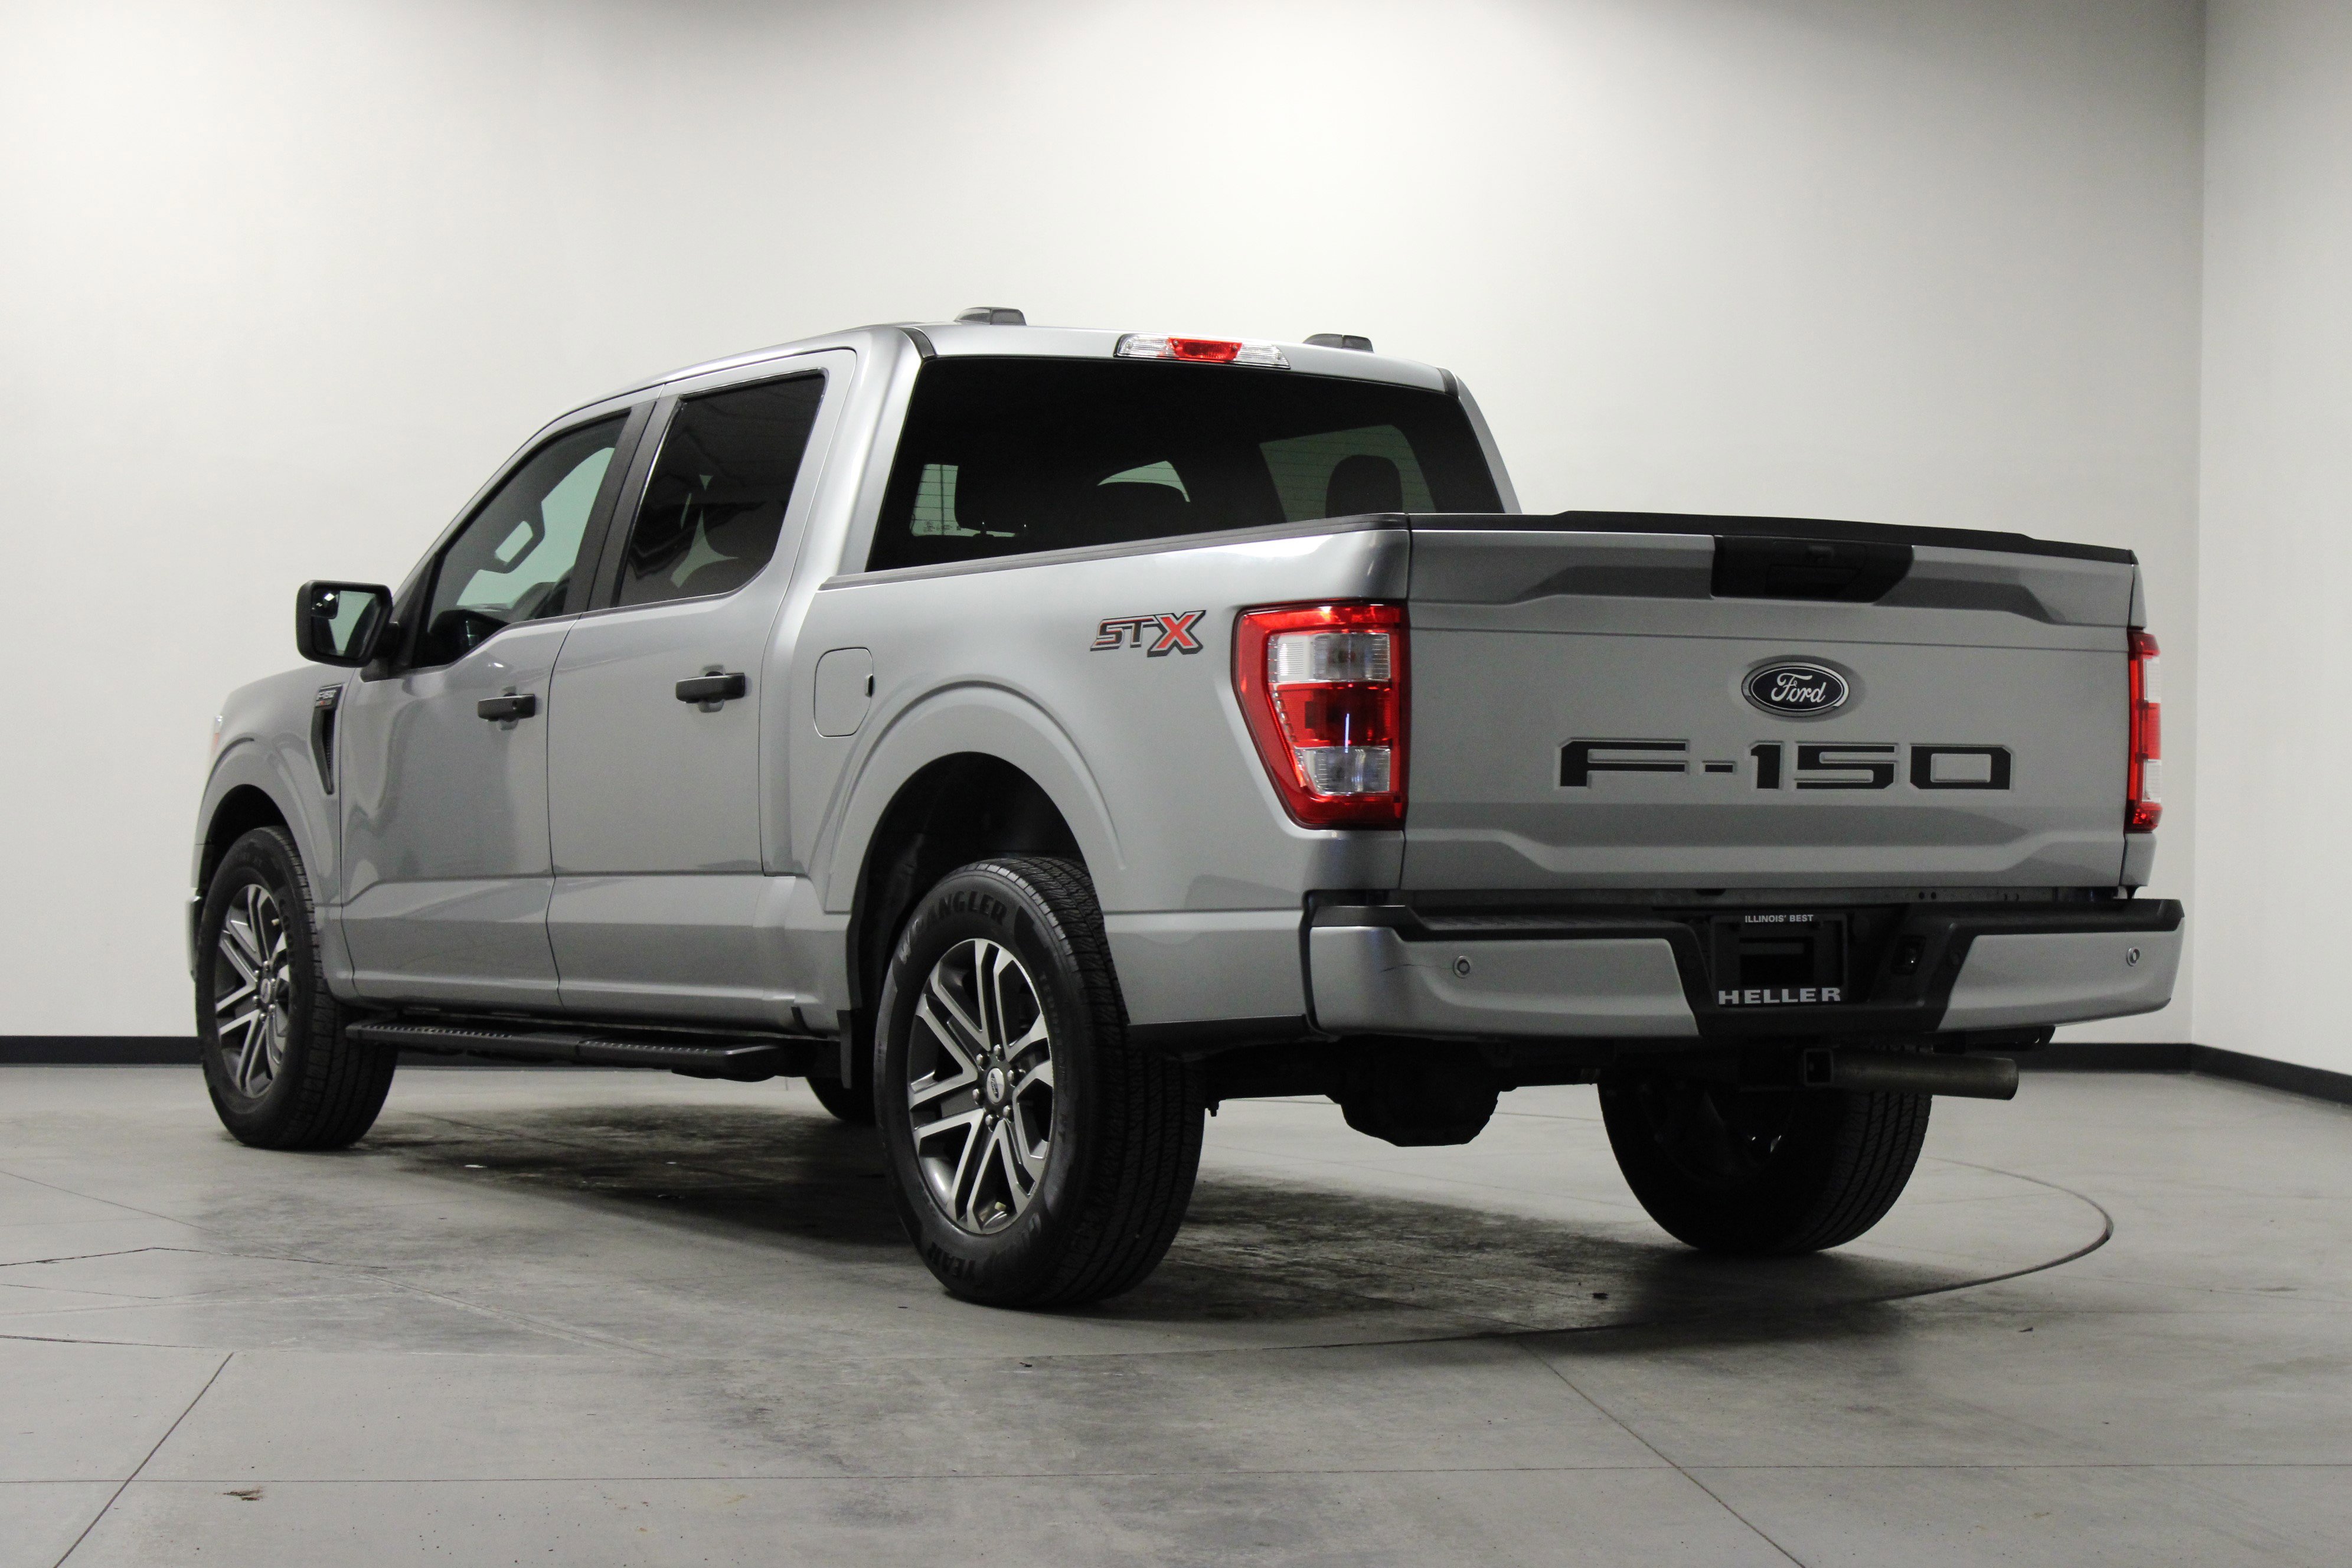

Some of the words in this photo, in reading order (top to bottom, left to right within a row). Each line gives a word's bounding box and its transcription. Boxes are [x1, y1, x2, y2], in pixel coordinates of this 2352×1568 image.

[1090, 610, 1206, 658] STX
[1771, 672, 1827, 703] Ford
[1556, 739, 2013, 790] F-150
[1718, 987, 1841, 1005] HELLER
